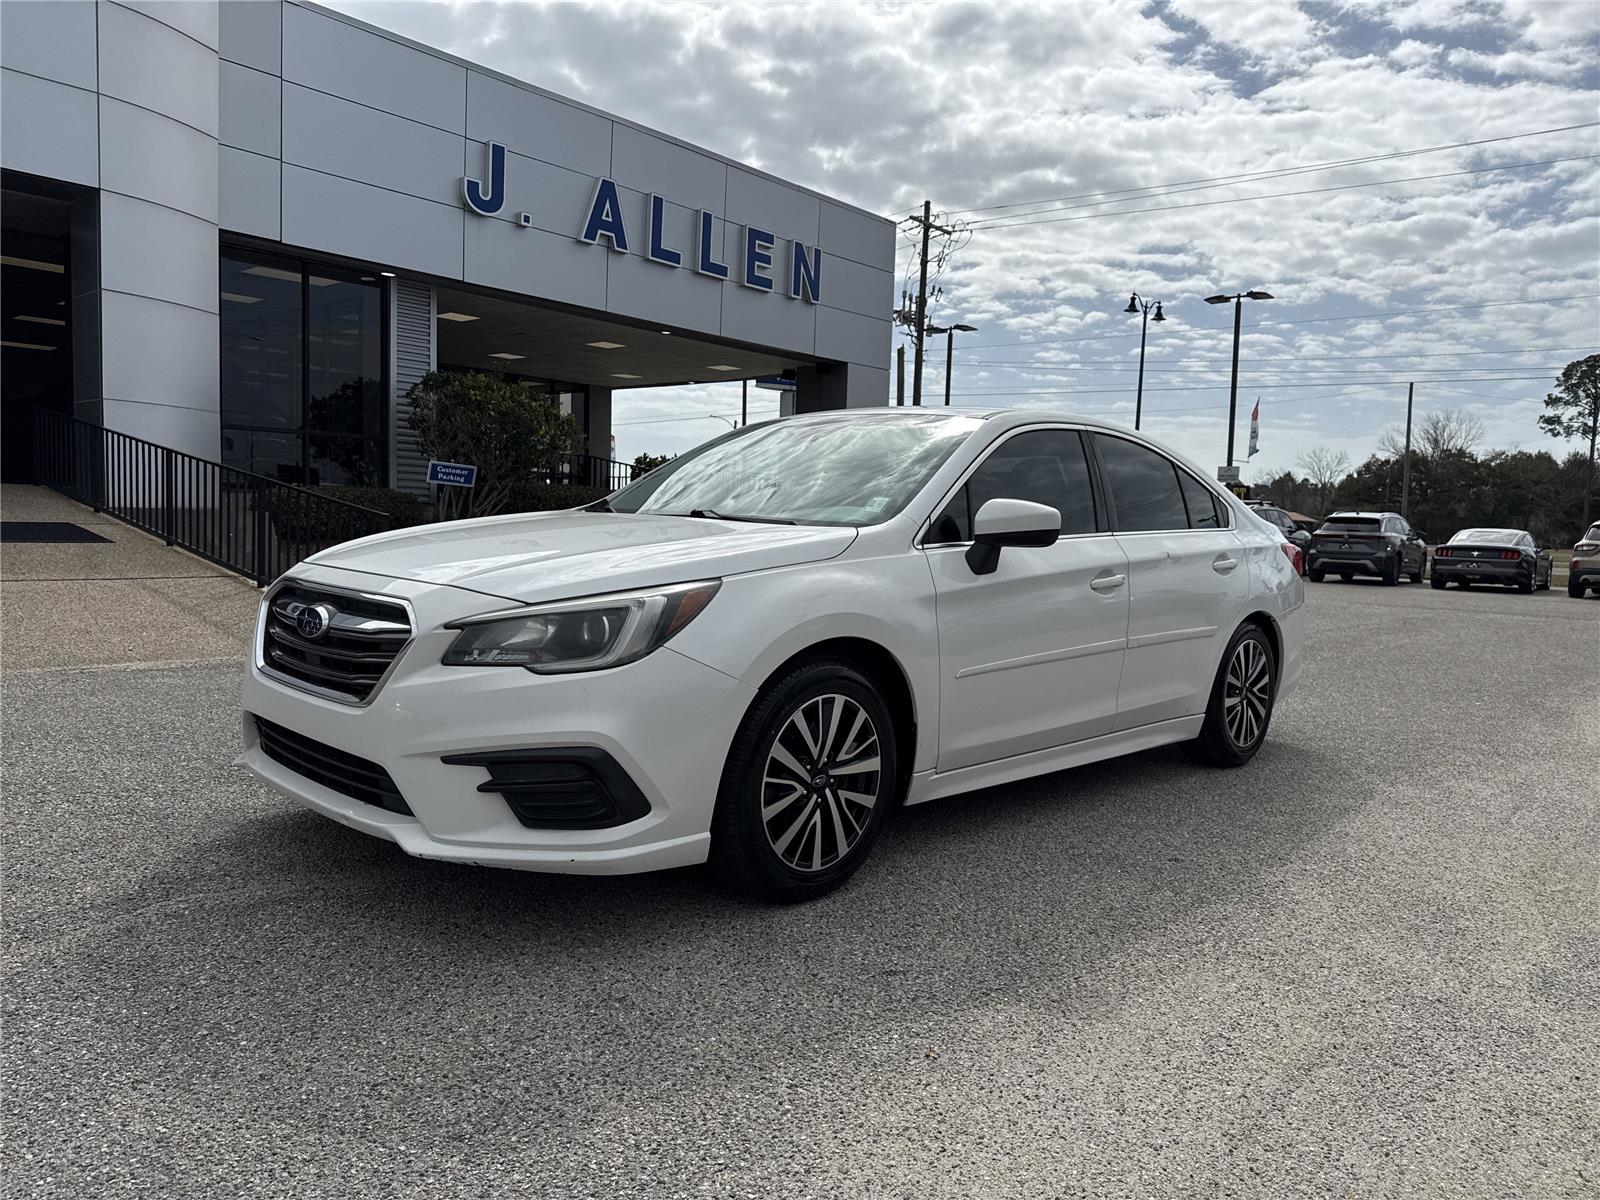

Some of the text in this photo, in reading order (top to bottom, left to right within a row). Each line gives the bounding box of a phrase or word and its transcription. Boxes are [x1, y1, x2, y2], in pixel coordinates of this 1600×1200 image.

[460, 140, 822, 304] J. ALLEN
[437, 466, 468, 475] Customer
[438, 473, 464, 482] Parking
